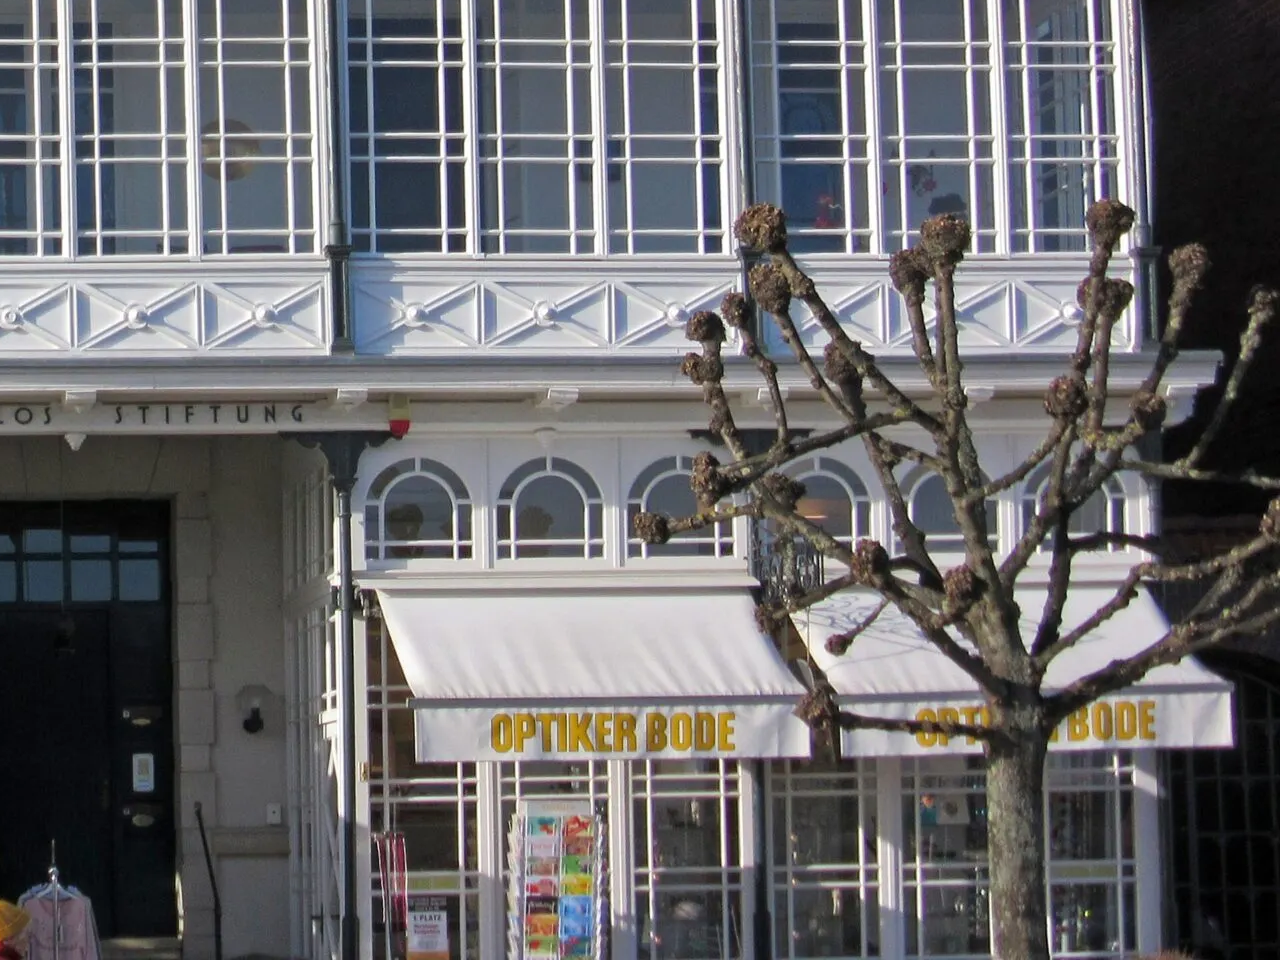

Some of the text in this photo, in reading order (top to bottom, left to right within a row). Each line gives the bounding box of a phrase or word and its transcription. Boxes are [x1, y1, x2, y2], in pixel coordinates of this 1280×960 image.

[115, 405, 303, 424] STIFTUNG
[490, 711, 736, 753] OPTIKER BODE
[1067, 700, 1157, 744] BODE
